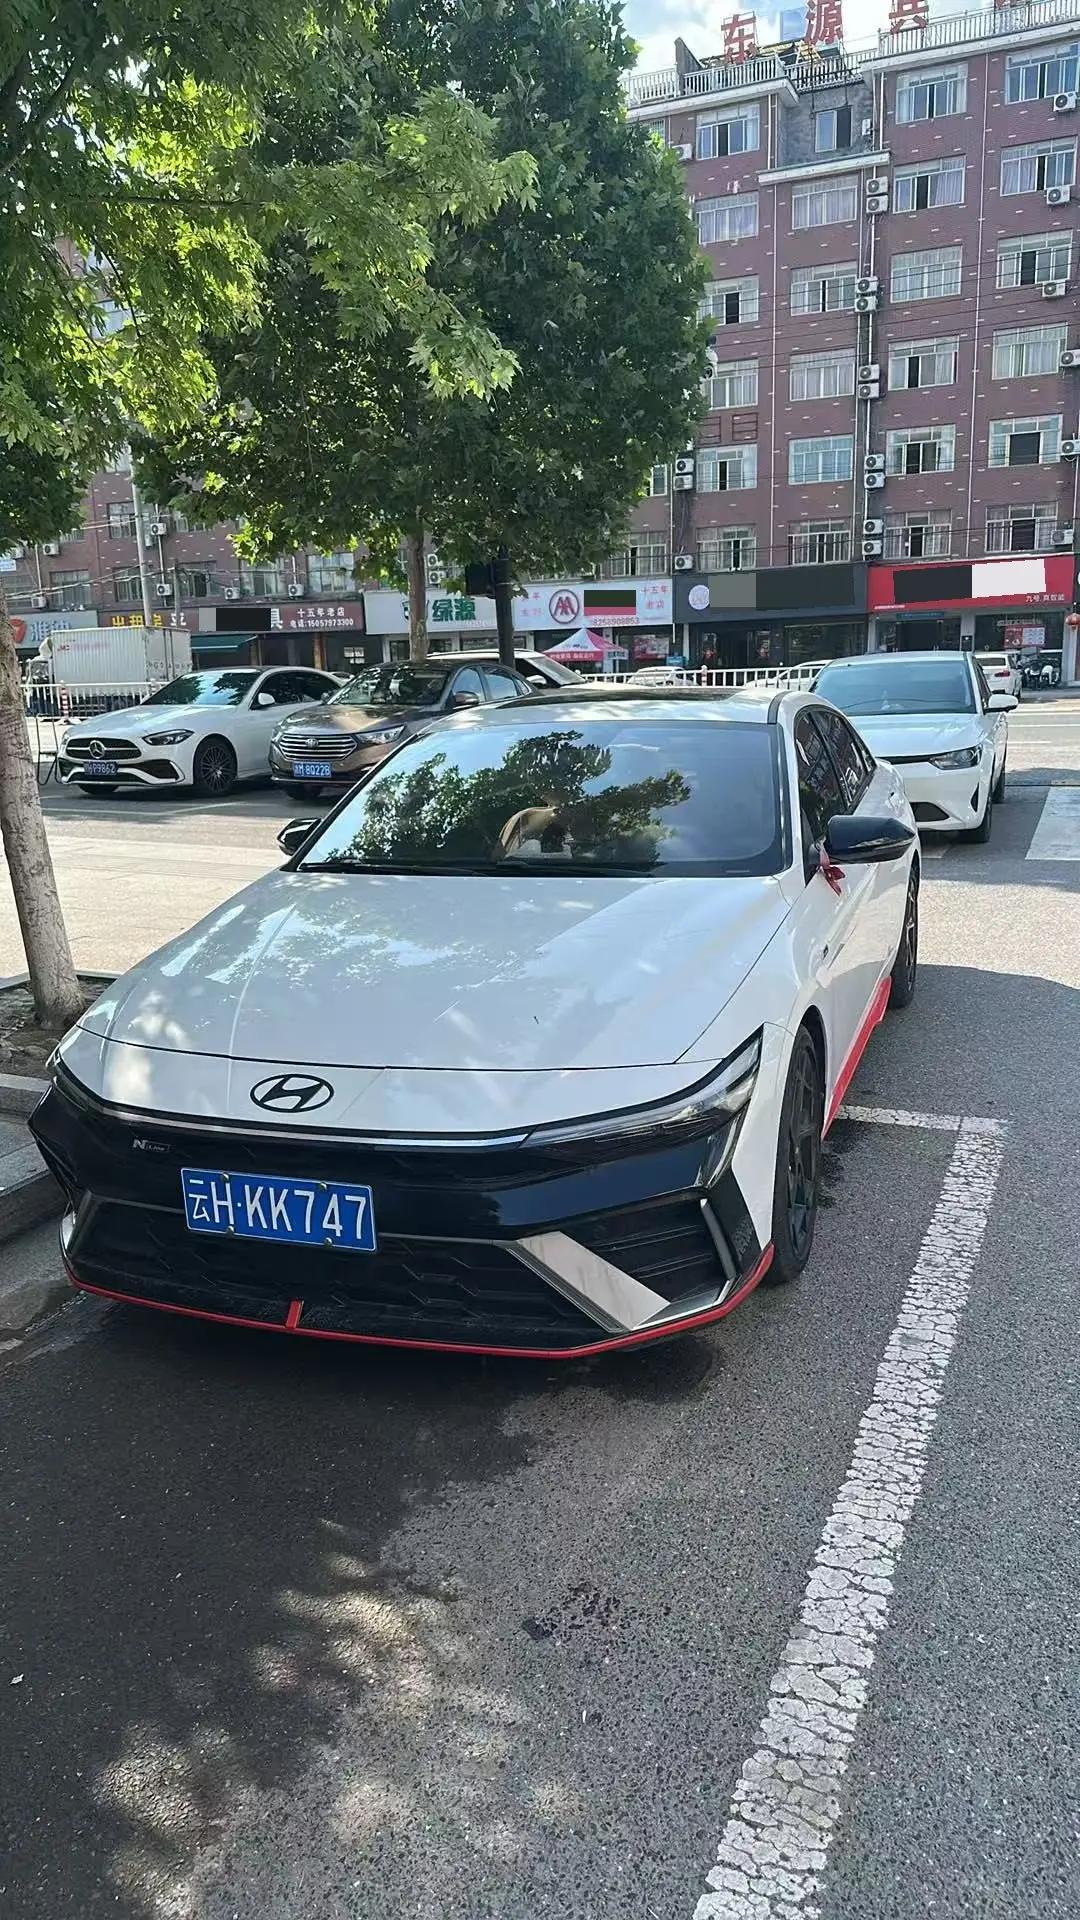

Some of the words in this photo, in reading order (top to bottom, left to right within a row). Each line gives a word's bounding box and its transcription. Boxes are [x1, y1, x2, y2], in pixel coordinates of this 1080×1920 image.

[296, 607, 344, 618] 十五年老店
[432, 598, 475, 622] 绿源
